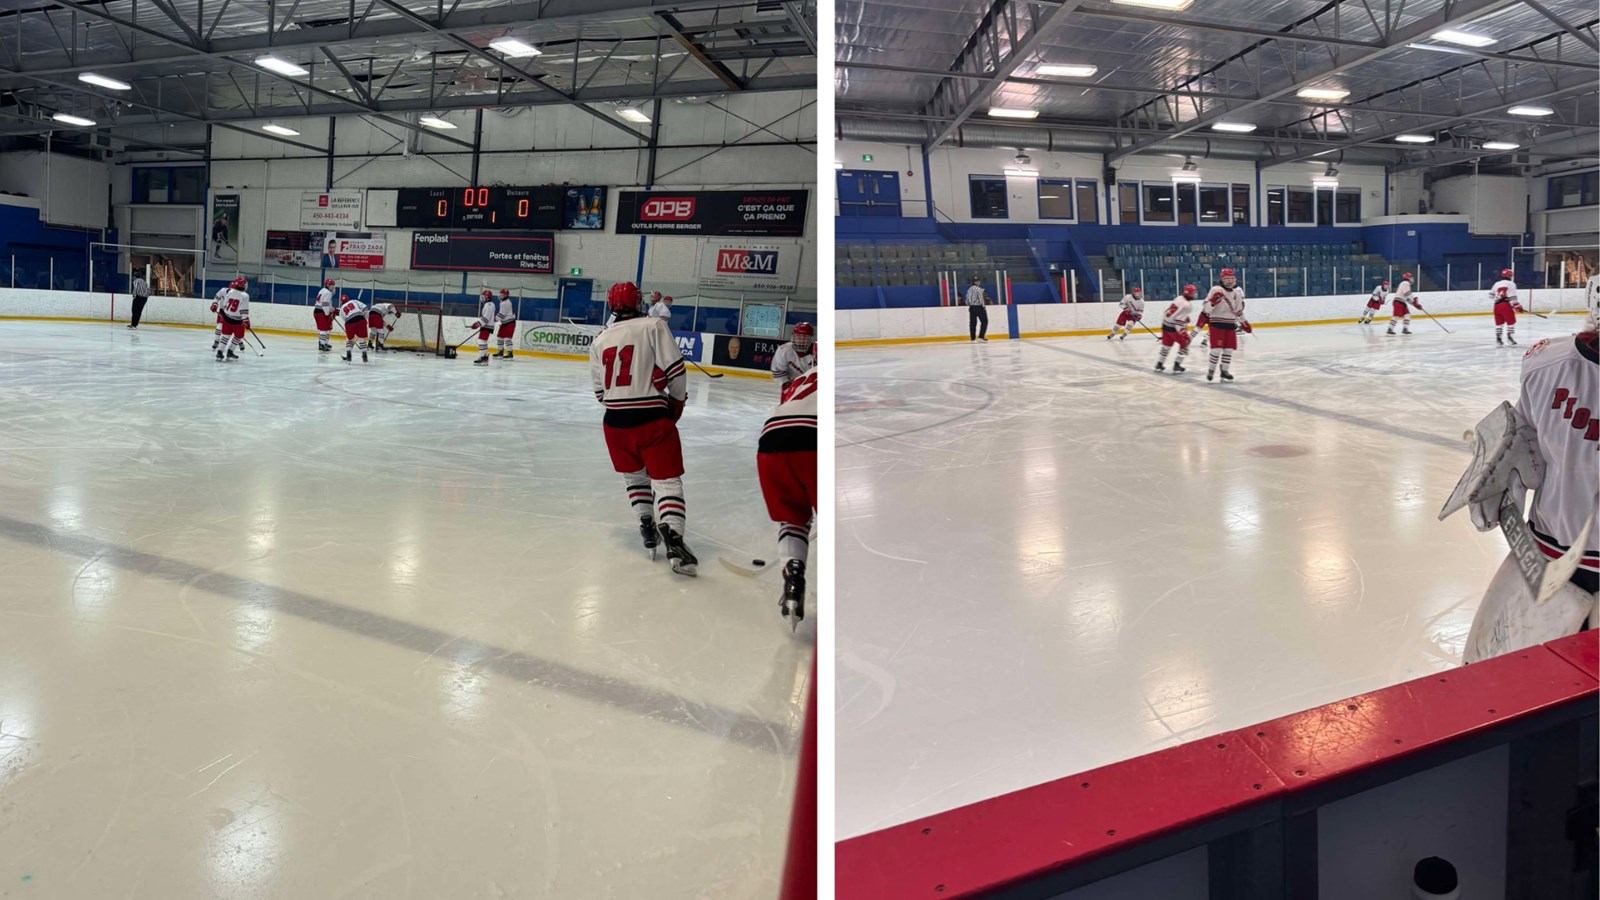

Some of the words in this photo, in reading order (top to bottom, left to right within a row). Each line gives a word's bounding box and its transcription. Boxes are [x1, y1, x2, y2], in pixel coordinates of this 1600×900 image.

[438, 200, 447, 217] 0
[518, 200, 529, 217] 0
[644, 201, 692, 217] OPB
[737, 204, 762, 212] C'EST
[762, 204, 775, 213] ÇA
[776, 204, 795, 212] QUE
[743, 213, 756, 222] ÇA
[756, 213, 787, 221] PREND
[414, 233, 449, 244] Fenplast
[489, 251, 513, 261] Portes
[514, 253, 521, 261] et
[522, 252, 550, 262] fenêtres
[720, 253, 775, 271] M&M
[520, 261, 550, 269] Rive-Sud
[532, 331, 594, 347] SPORTMÉDI
[754, 342, 779, 352] FRA
[1551, 387, 1599, 451] PION
